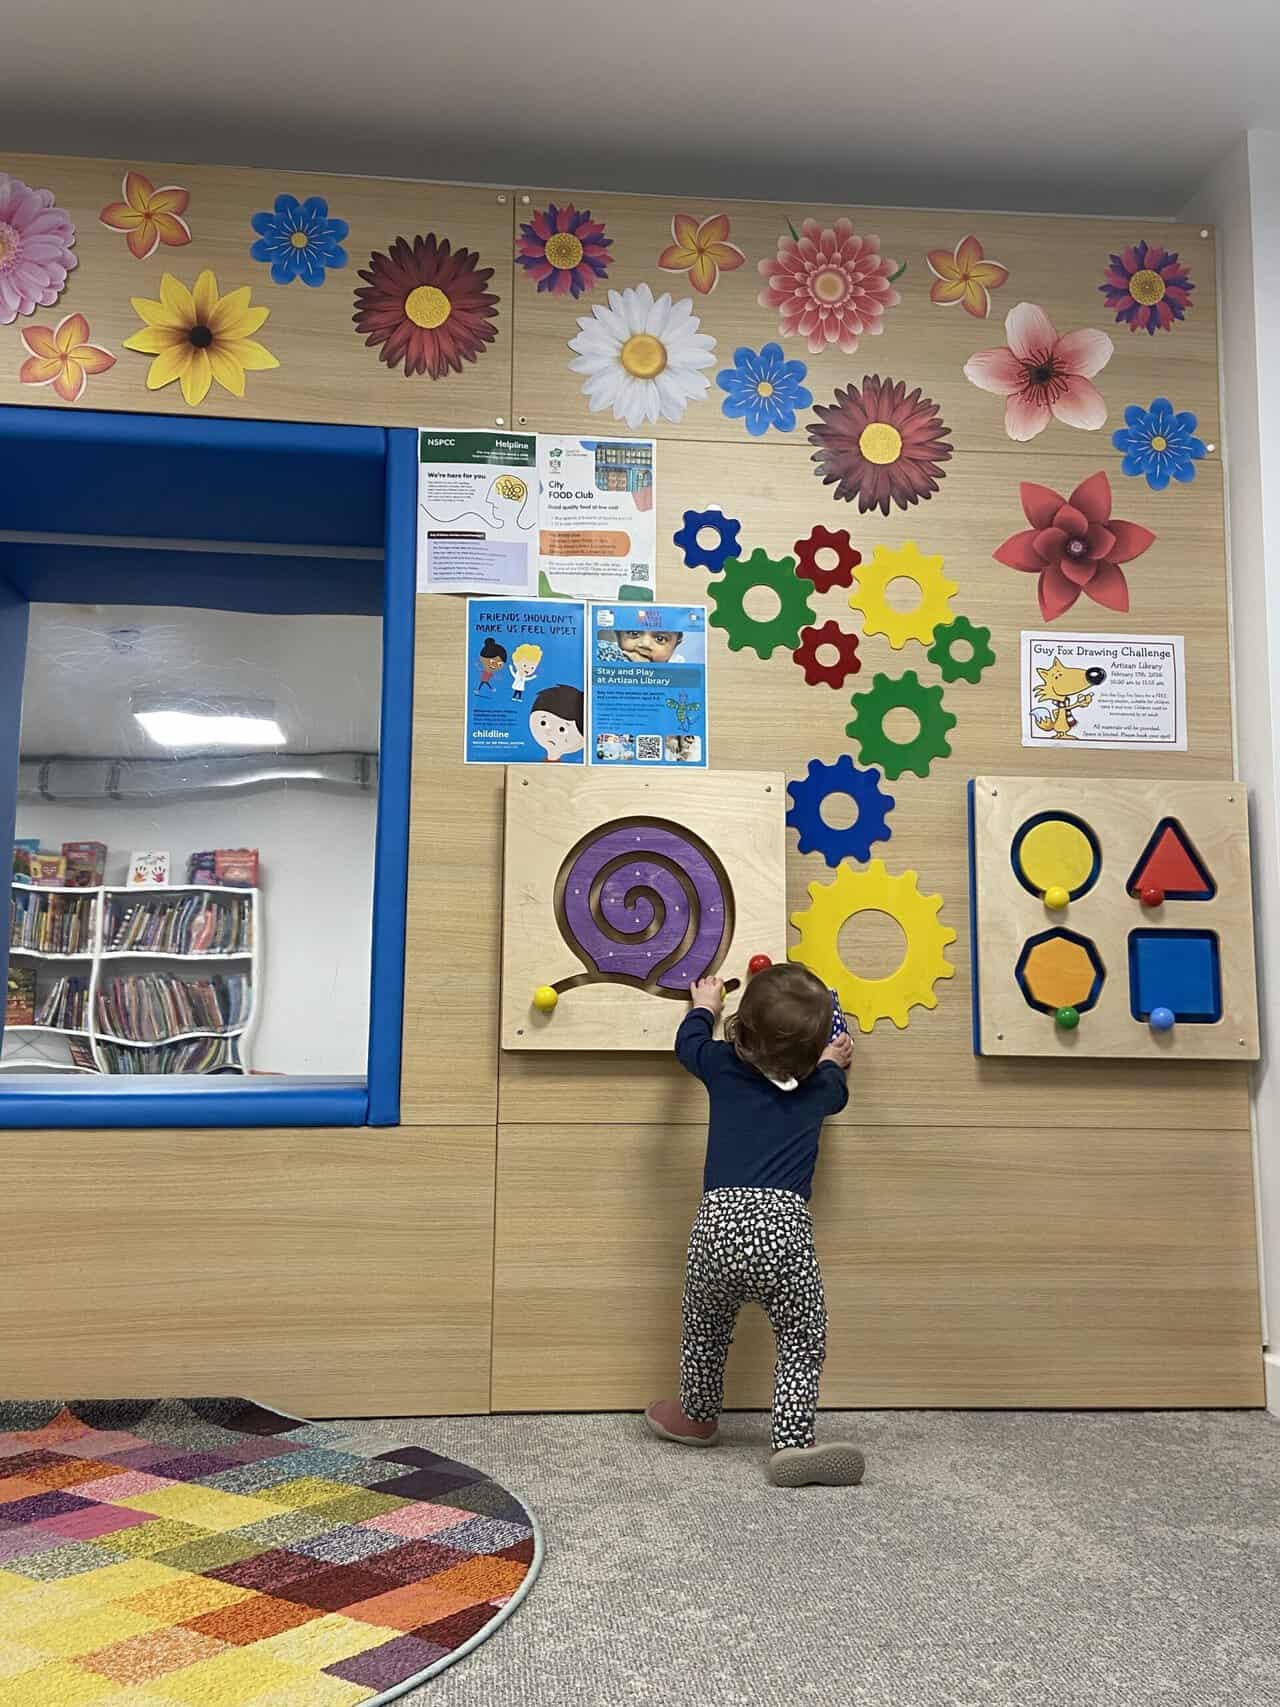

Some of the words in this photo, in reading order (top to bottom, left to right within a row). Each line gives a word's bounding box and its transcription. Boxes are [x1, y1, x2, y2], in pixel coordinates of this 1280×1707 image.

[495, 440, 529, 450] Helpline
[548, 480, 564, 490] City
[575, 491, 594, 500] Club
[480, 612, 520, 622] FRIENDS
[523, 614, 575, 624] SHOULDN'T
[476, 624, 502, 633] MAKE
[506, 624, 517, 633] US
[520, 624, 545, 634] FEEL
[550, 626, 577, 636] UPSET
[1034, 644, 1054, 656] Guy
[1057, 645, 1074, 655] Fox
[1076, 646, 1118, 658] Drawing
[1121, 646, 1171, 660] Challenge
[1138, 662, 1162, 671] Library
[596, 667, 616, 676] Stay
[636, 668, 655, 677] Play
[640, 678, 671, 686] Library
[472, 730, 510, 738] childline
